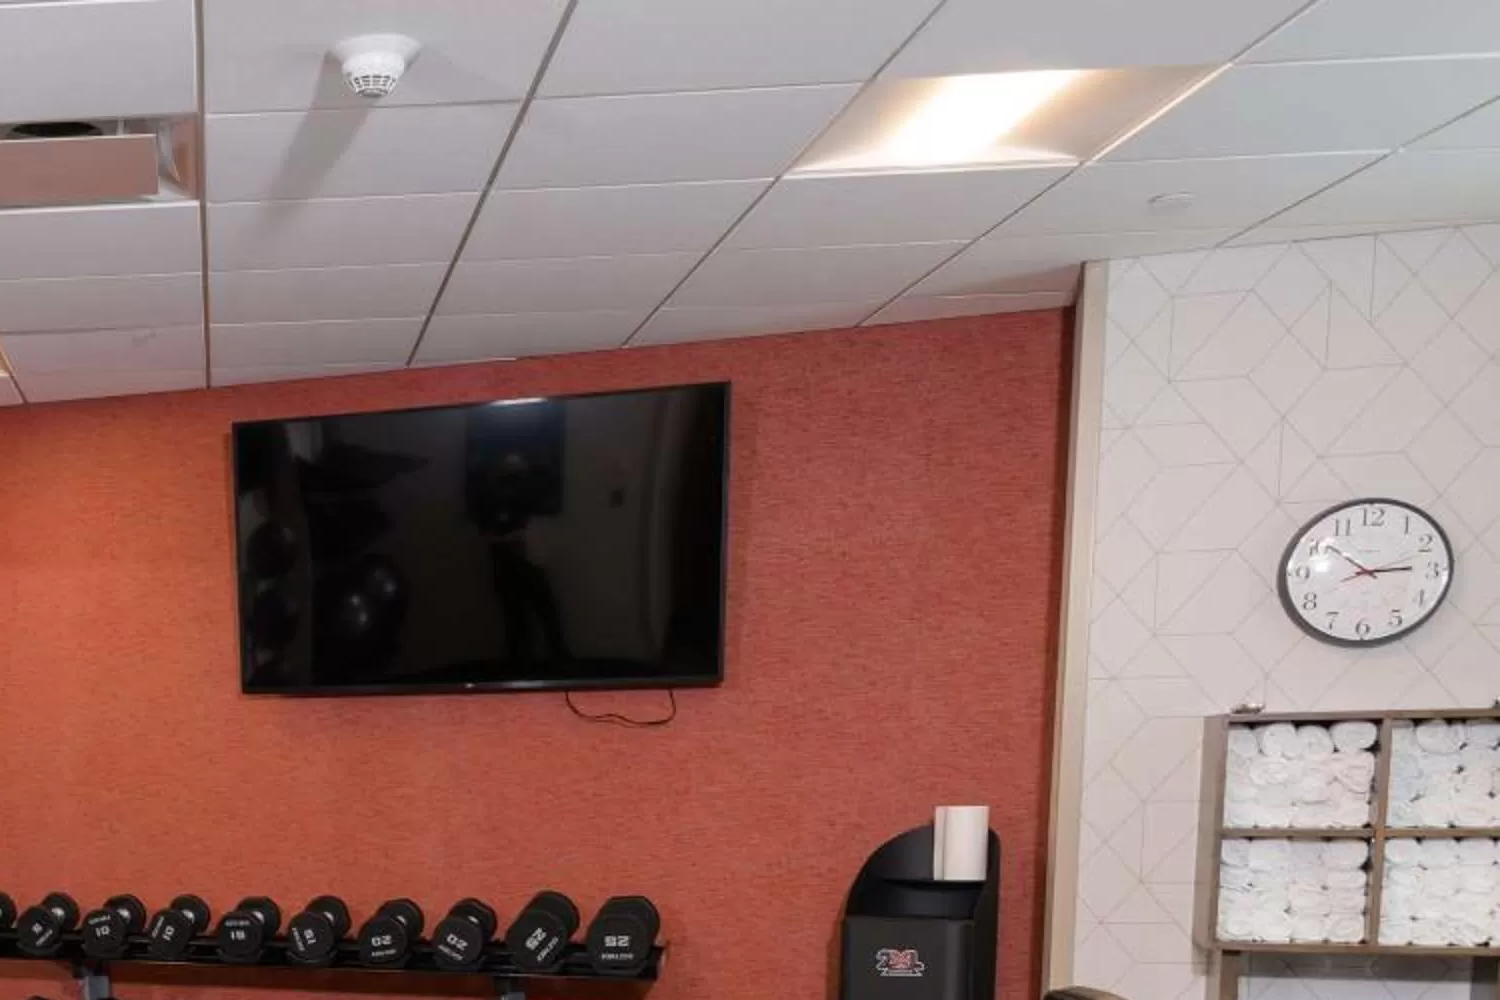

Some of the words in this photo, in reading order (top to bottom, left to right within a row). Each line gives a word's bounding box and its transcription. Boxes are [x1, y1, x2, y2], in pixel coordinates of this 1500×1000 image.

[1335, 518, 1351, 536] 11
[1362, 508, 1385, 527] 12
[1418, 536, 1433, 552] 2
[1425, 561, 1440, 580] 3
[1303, 592, 1318, 611] 8
[1326, 611, 1340, 630] 7
[1355, 618, 1371, 636] 6
[1388, 608, 1403, 627] 5
